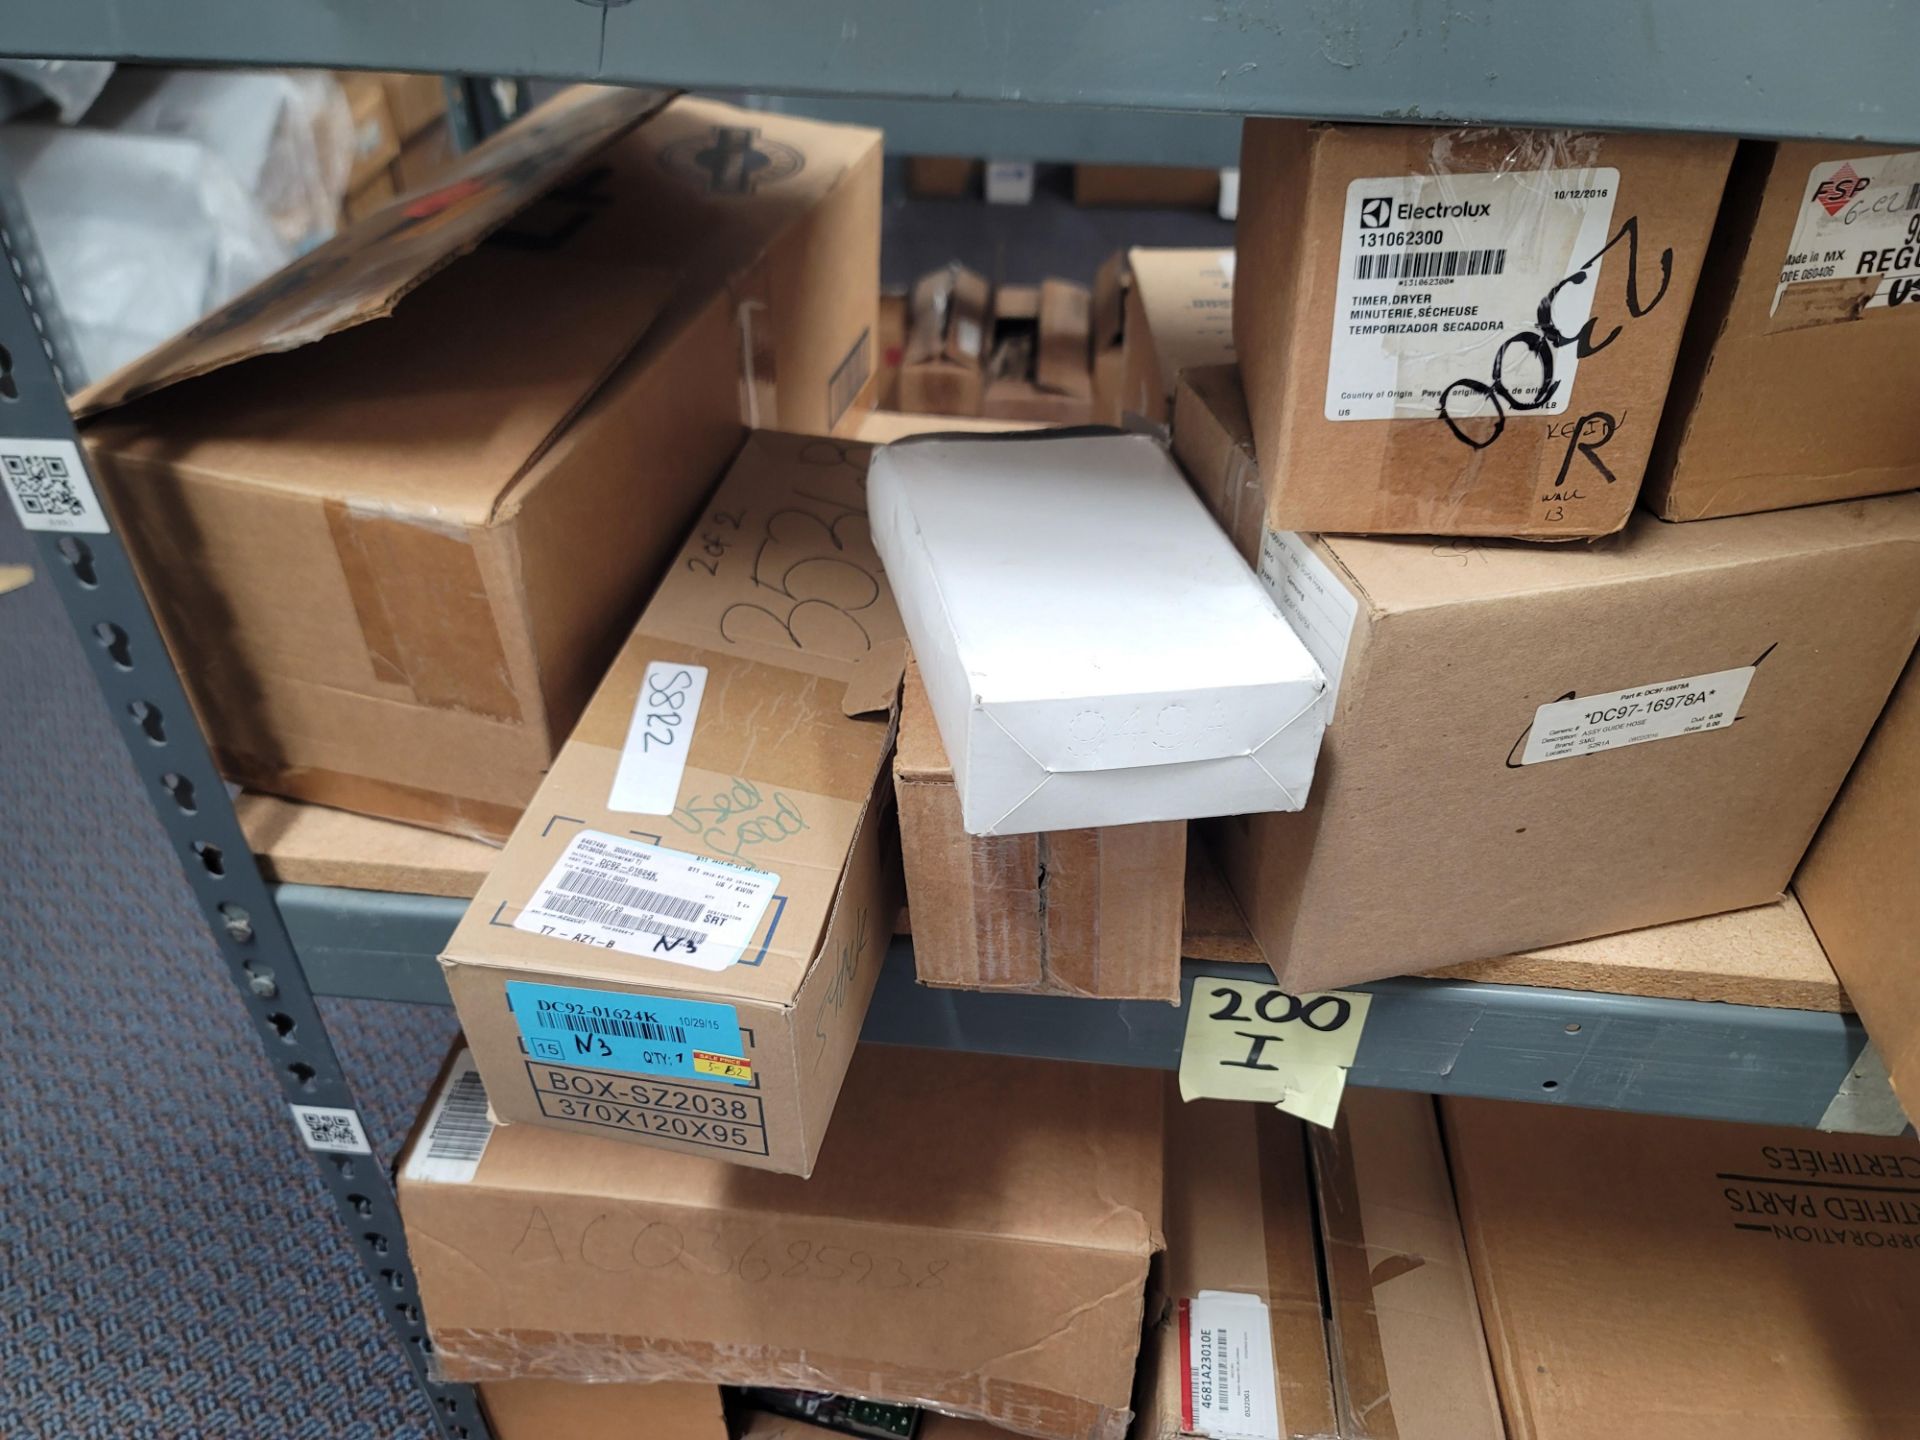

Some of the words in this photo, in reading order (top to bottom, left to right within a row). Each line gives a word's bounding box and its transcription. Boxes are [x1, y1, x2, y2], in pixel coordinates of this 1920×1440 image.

[1553, 189, 1608, 199] 10/12/2016
[1811, 177, 1870, 203] FSP
[1397, 201, 1491, 220] Electrolux
[1359, 230, 1444, 248] 131062300
[1823, 249, 1846, 262] MX
[1352, 294, 1432, 306] TIMER,DRYER
[1350, 304, 1479, 321] MINUTERIE,SÉCHEUSE
[1349, 323, 1438, 335] TEMPORIZADOR
[1442, 321, 1504, 332] SECADORA
[1341, 391, 1373, 400] Country
[1376, 390, 1385, 398] of
[1387, 389, 1413, 399] Origin
[1338, 409, 1351, 417] US
[1602, 722, 1625, 733] GUIDE
[1625, 718, 1648, 729] HOSE
[703, 913, 728, 927] SRT
[537, 999, 659, 1024] DC92-01624K
[1209, 988, 1352, 1032] 200
[679, 1016, 720, 1030] 10/29/15
[537, 1044, 559, 1055] 15
[549, 1071, 748, 1121] BOX-SZ2038
[558, 1098, 748, 1146] 370X120X95
[1724, 1188, 1817, 1218] PARTS
[1200, 1329, 1212, 1409] 4681A23010E
